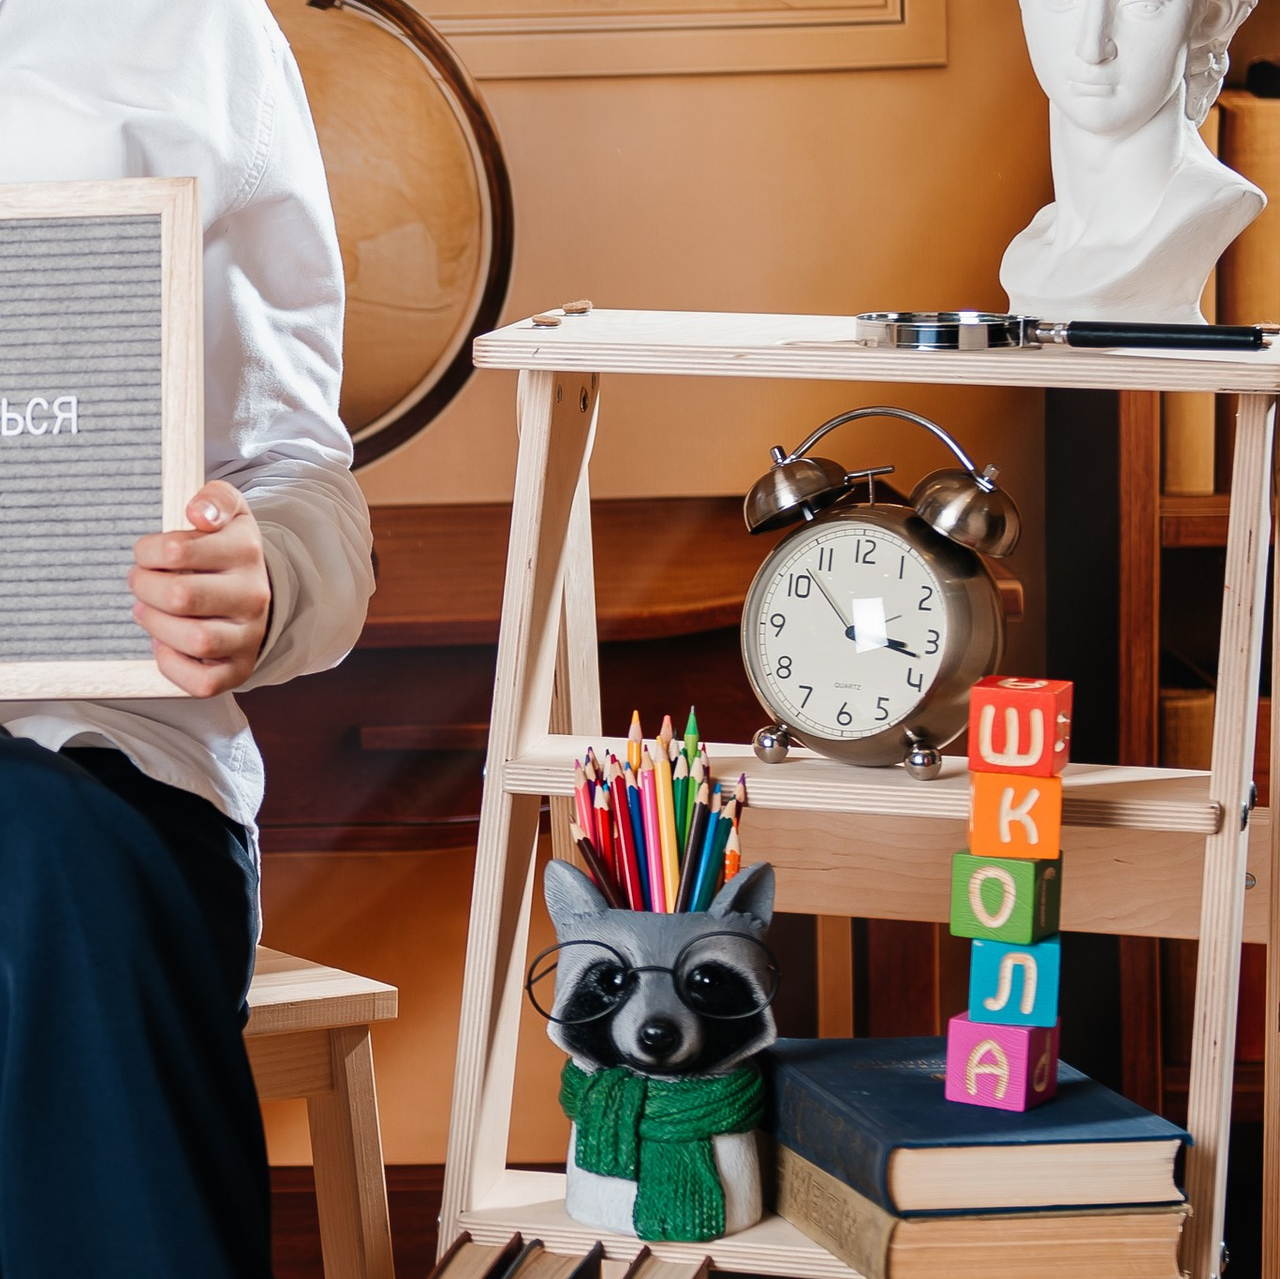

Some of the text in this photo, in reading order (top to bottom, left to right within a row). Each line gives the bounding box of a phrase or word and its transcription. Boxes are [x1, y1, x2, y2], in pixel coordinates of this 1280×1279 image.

[818, 547, 834, 572] 11
[855, 539, 876, 564] 12
[787, 573, 811, 598] 10
[918, 586, 933, 611] 2
[770, 613, 786, 637] 9
[924, 629, 940, 654] 3
[776, 655, 792, 679] 8
[906, 668, 924, 693] 4
[798, 685, 813, 709] 7
[874, 697, 890, 721] 5
[836, 702, 852, 726] 6
